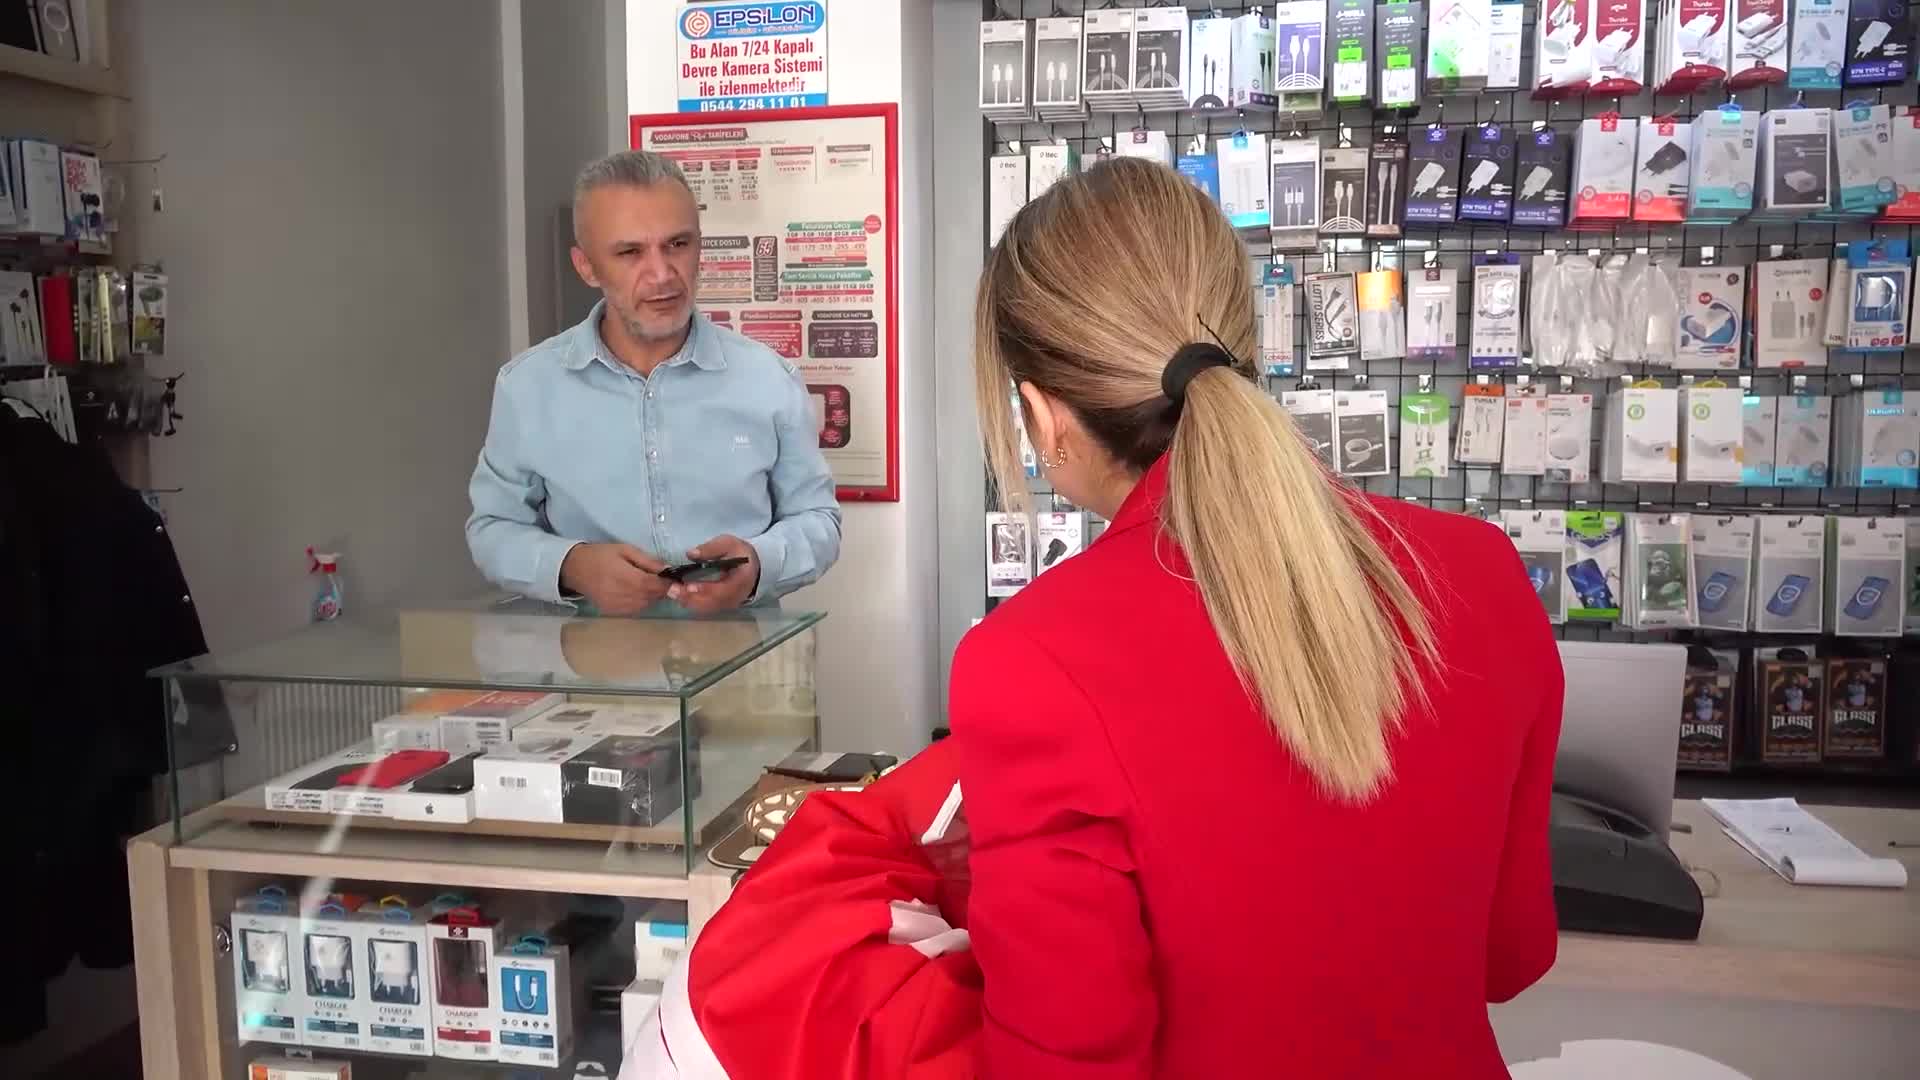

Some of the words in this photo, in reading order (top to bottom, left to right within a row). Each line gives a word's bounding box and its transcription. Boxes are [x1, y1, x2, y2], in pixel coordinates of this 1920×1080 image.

[690, 44, 707, 60] Bu
[711, 42, 739, 59] Alan
[742, 40, 770, 57] 7/24
[774, 38, 814, 57] Kapalı
[682, 63, 718, 79] Devre
[722, 61, 770, 77] Kamera
[774, 57, 823, 74] Sistemi
[700, 81, 716, 97] ile
[700, 100, 733, 112] 0544
[739, 98, 765, 110] 294
[770, 97, 784, 109] 11
[790, 96, 806, 108] 01
[1312, 284, 1323, 310] LOTTO
[1314, 312, 1325, 340] SERIES
[1772, 714, 1815, 731] GLASS
[1681, 723, 1724, 740] GLASS
[314, 1000, 349, 1011] CHARGER
[379, 1006, 413, 1017] CHARGER
[445, 1010, 479, 1019] CHARGER
